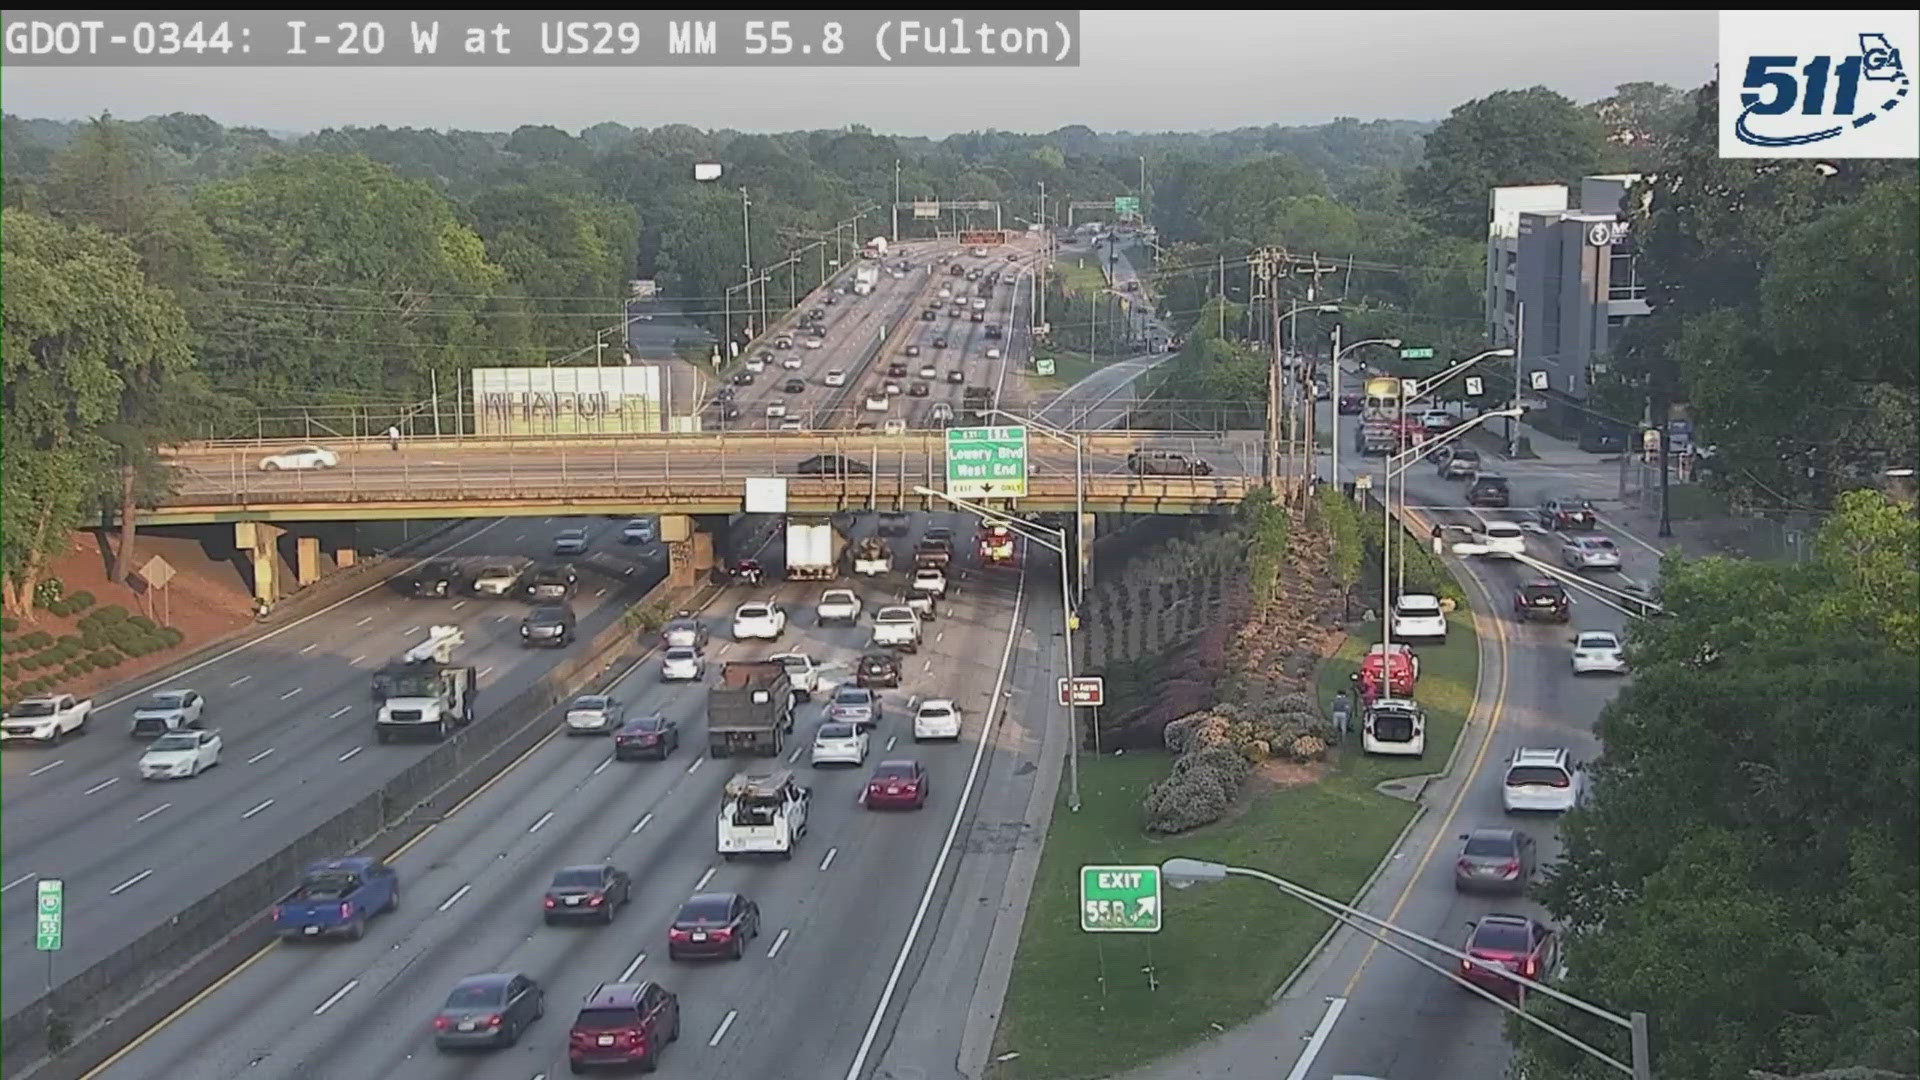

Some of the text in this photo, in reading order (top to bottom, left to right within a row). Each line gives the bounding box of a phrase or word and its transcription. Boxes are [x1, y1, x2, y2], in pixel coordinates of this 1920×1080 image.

[957, 464, 1017, 477] West End
[1098, 872, 1142, 889] EXIT
